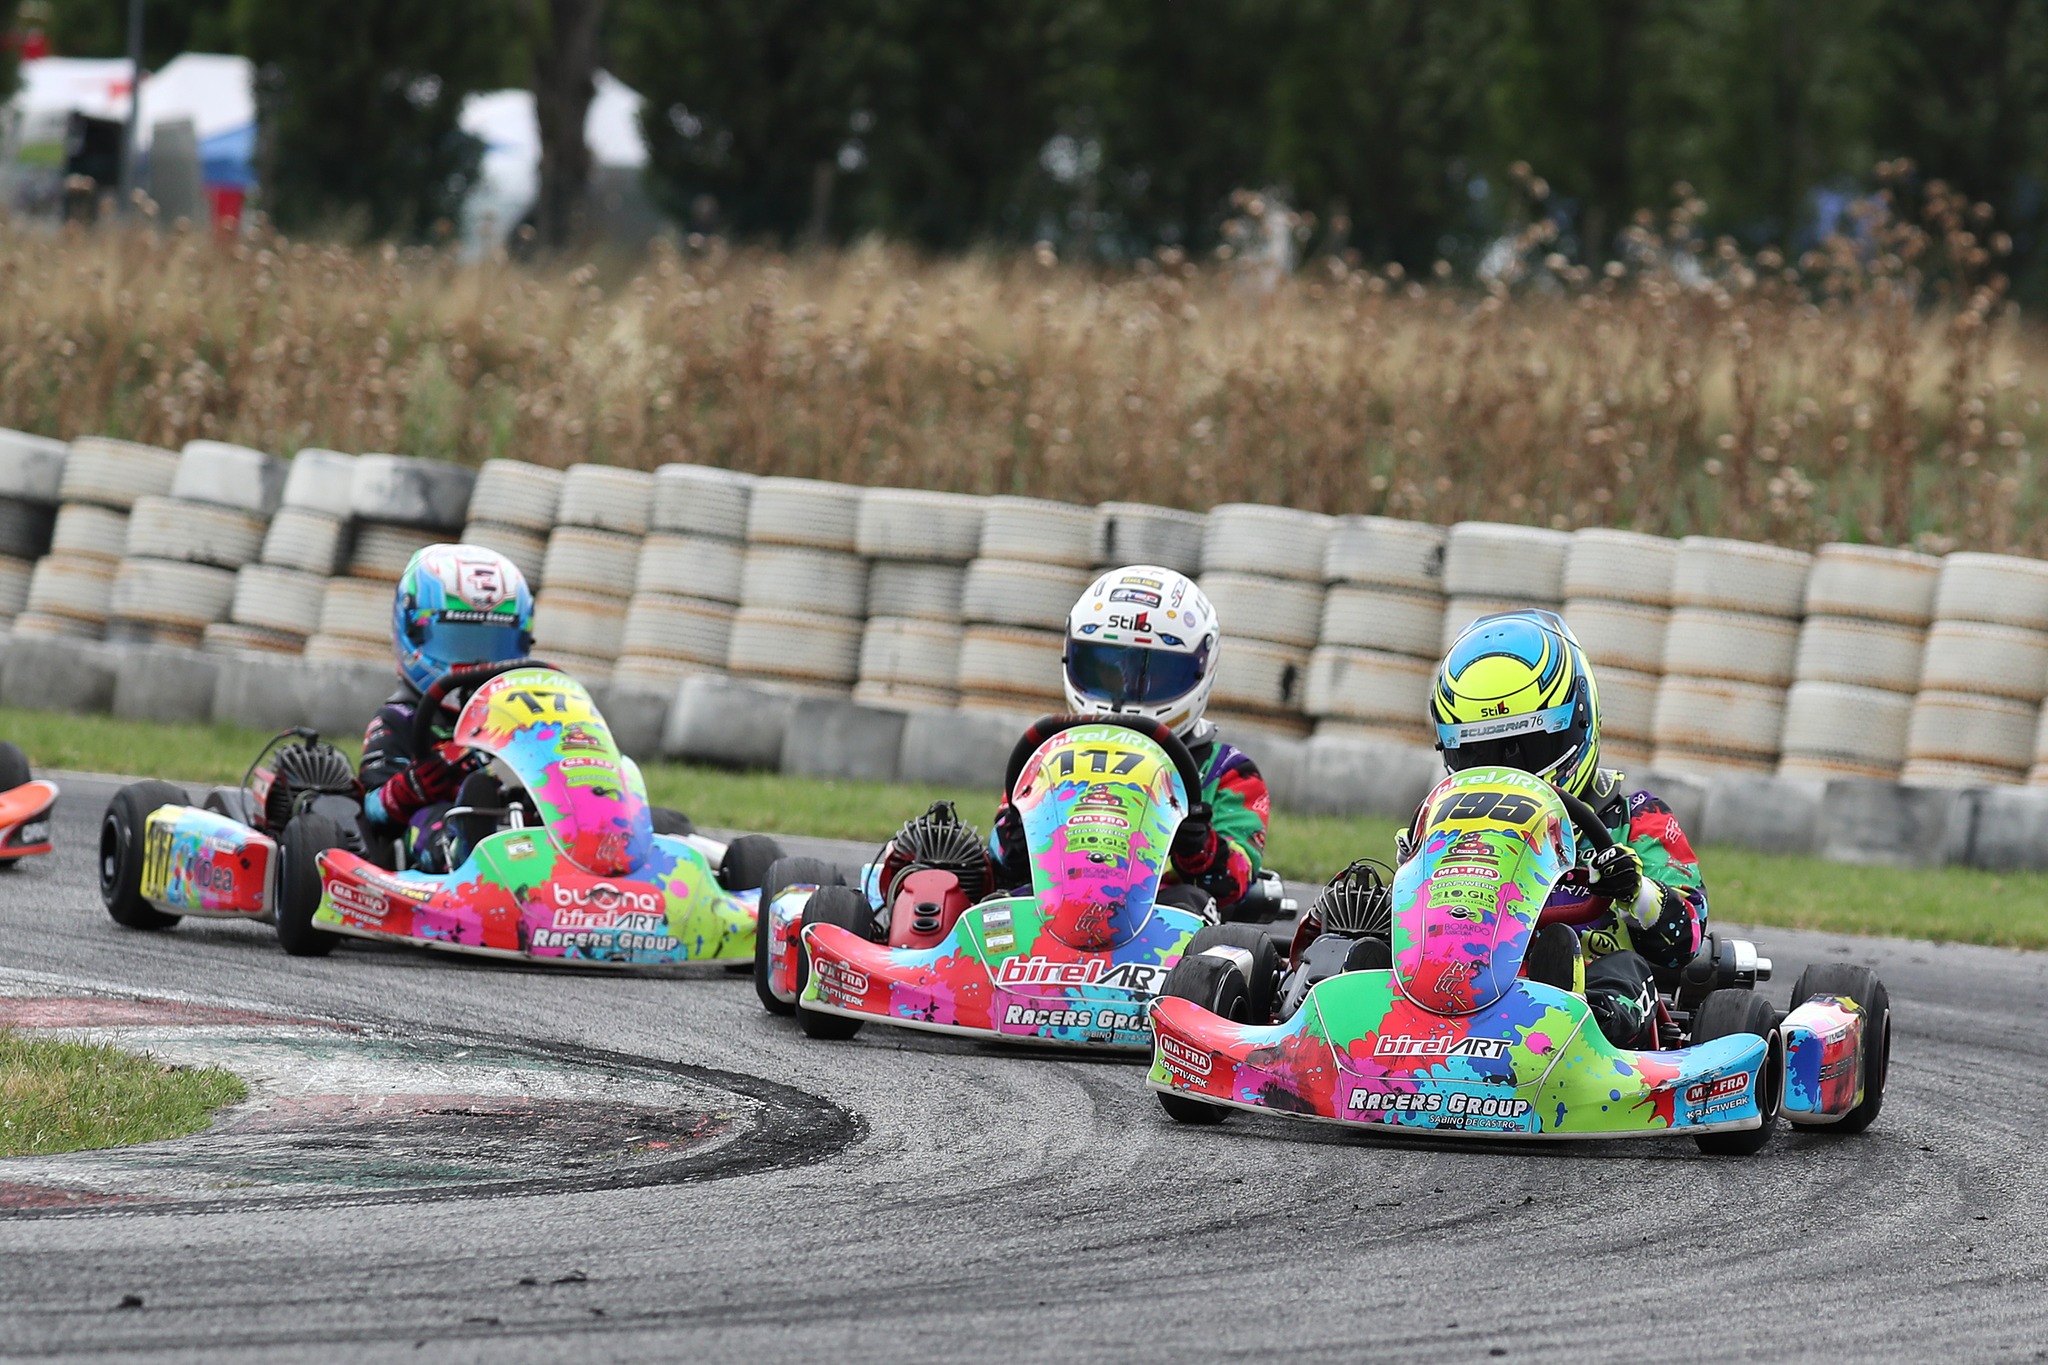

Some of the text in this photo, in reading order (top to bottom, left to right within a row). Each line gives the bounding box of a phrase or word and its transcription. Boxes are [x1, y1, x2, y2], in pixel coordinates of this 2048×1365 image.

[1108, 611, 1152, 633] Stilo
[1480, 700, 1510, 717] Stilo
[1460, 720, 1529, 738] SCUDERIA
[1530, 715, 1544, 729] 76
[1048, 749, 1146, 777] 117
[1436, 771, 1549, 797] birelART
[1430, 792, 1543, 829] 195
[532, 928, 680, 952] RACERS GROUP
[1004, 1003, 1152, 1032] RACERS GROU
[1376, 1036, 1512, 1058] birelART
[1159, 1058, 1209, 1089] KRAFTWERK
[1348, 1088, 1528, 1118] RACERS GROUP
[1429, 1114, 1516, 1130] SABINO DE CASTRO
